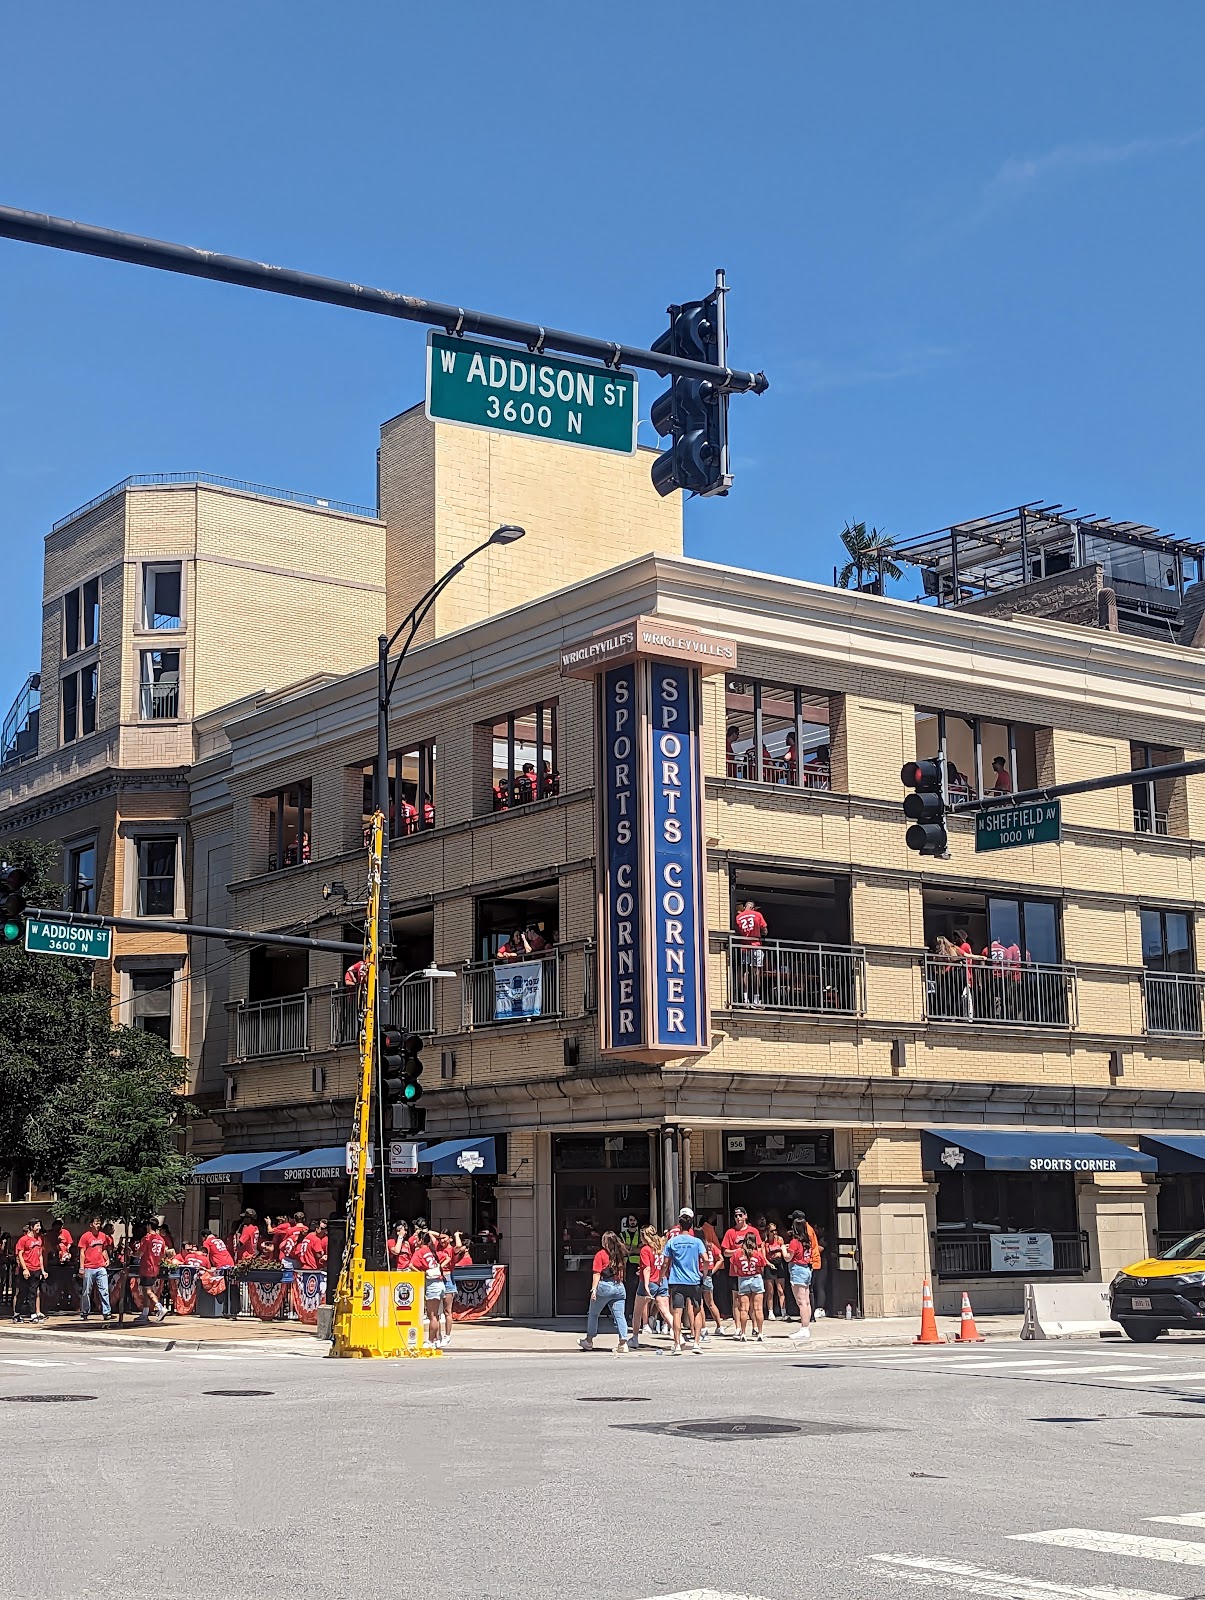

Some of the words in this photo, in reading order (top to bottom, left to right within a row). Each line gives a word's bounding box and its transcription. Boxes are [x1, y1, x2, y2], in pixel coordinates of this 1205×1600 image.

[440, 350, 457, 374] W
[467, 352, 594, 406] ADDISON
[603, 383, 627, 407] ST
[486, 396, 552, 428] 3600
[567, 411, 582, 434] N
[562, 631, 634, 666] WRIGLEYVILLE'S
[641, 631, 733, 659] WRIGLEYVILLE'S
[613, 680, 632, 844] SPORTS
[660, 678, 682, 843] SPORTS
[979, 819, 984, 831] N
[986, 807, 1044, 832] SHEFFIELD
[1046, 807, 1056, 820] AV
[1000, 830, 1022, 844] 1000
[1027, 828, 1035, 840] W
[741, 917, 755, 929] 23
[31, 924, 39, 934] W
[41, 924, 94, 942] ADDISON
[96, 932, 107, 942] ST
[49, 940, 76, 951] 3600
[81, 944, 89, 953] N
[616, 863, 635, 1034] CORNER
[662, 862, 686, 1033] CORNER
[991, 950, 1004, 960] 23
[730, 1140, 743, 1148] 956
[284, 1169, 311, 1180] SPORTS
[312, 1167, 340, 1179] CORNER
[1029, 1158, 1072, 1170] SPORTS
[1074, 1159, 1116, 1171] CORNER
[206, 1173, 231, 1183] CORNER
[654, 1254, 665, 1265] 23
